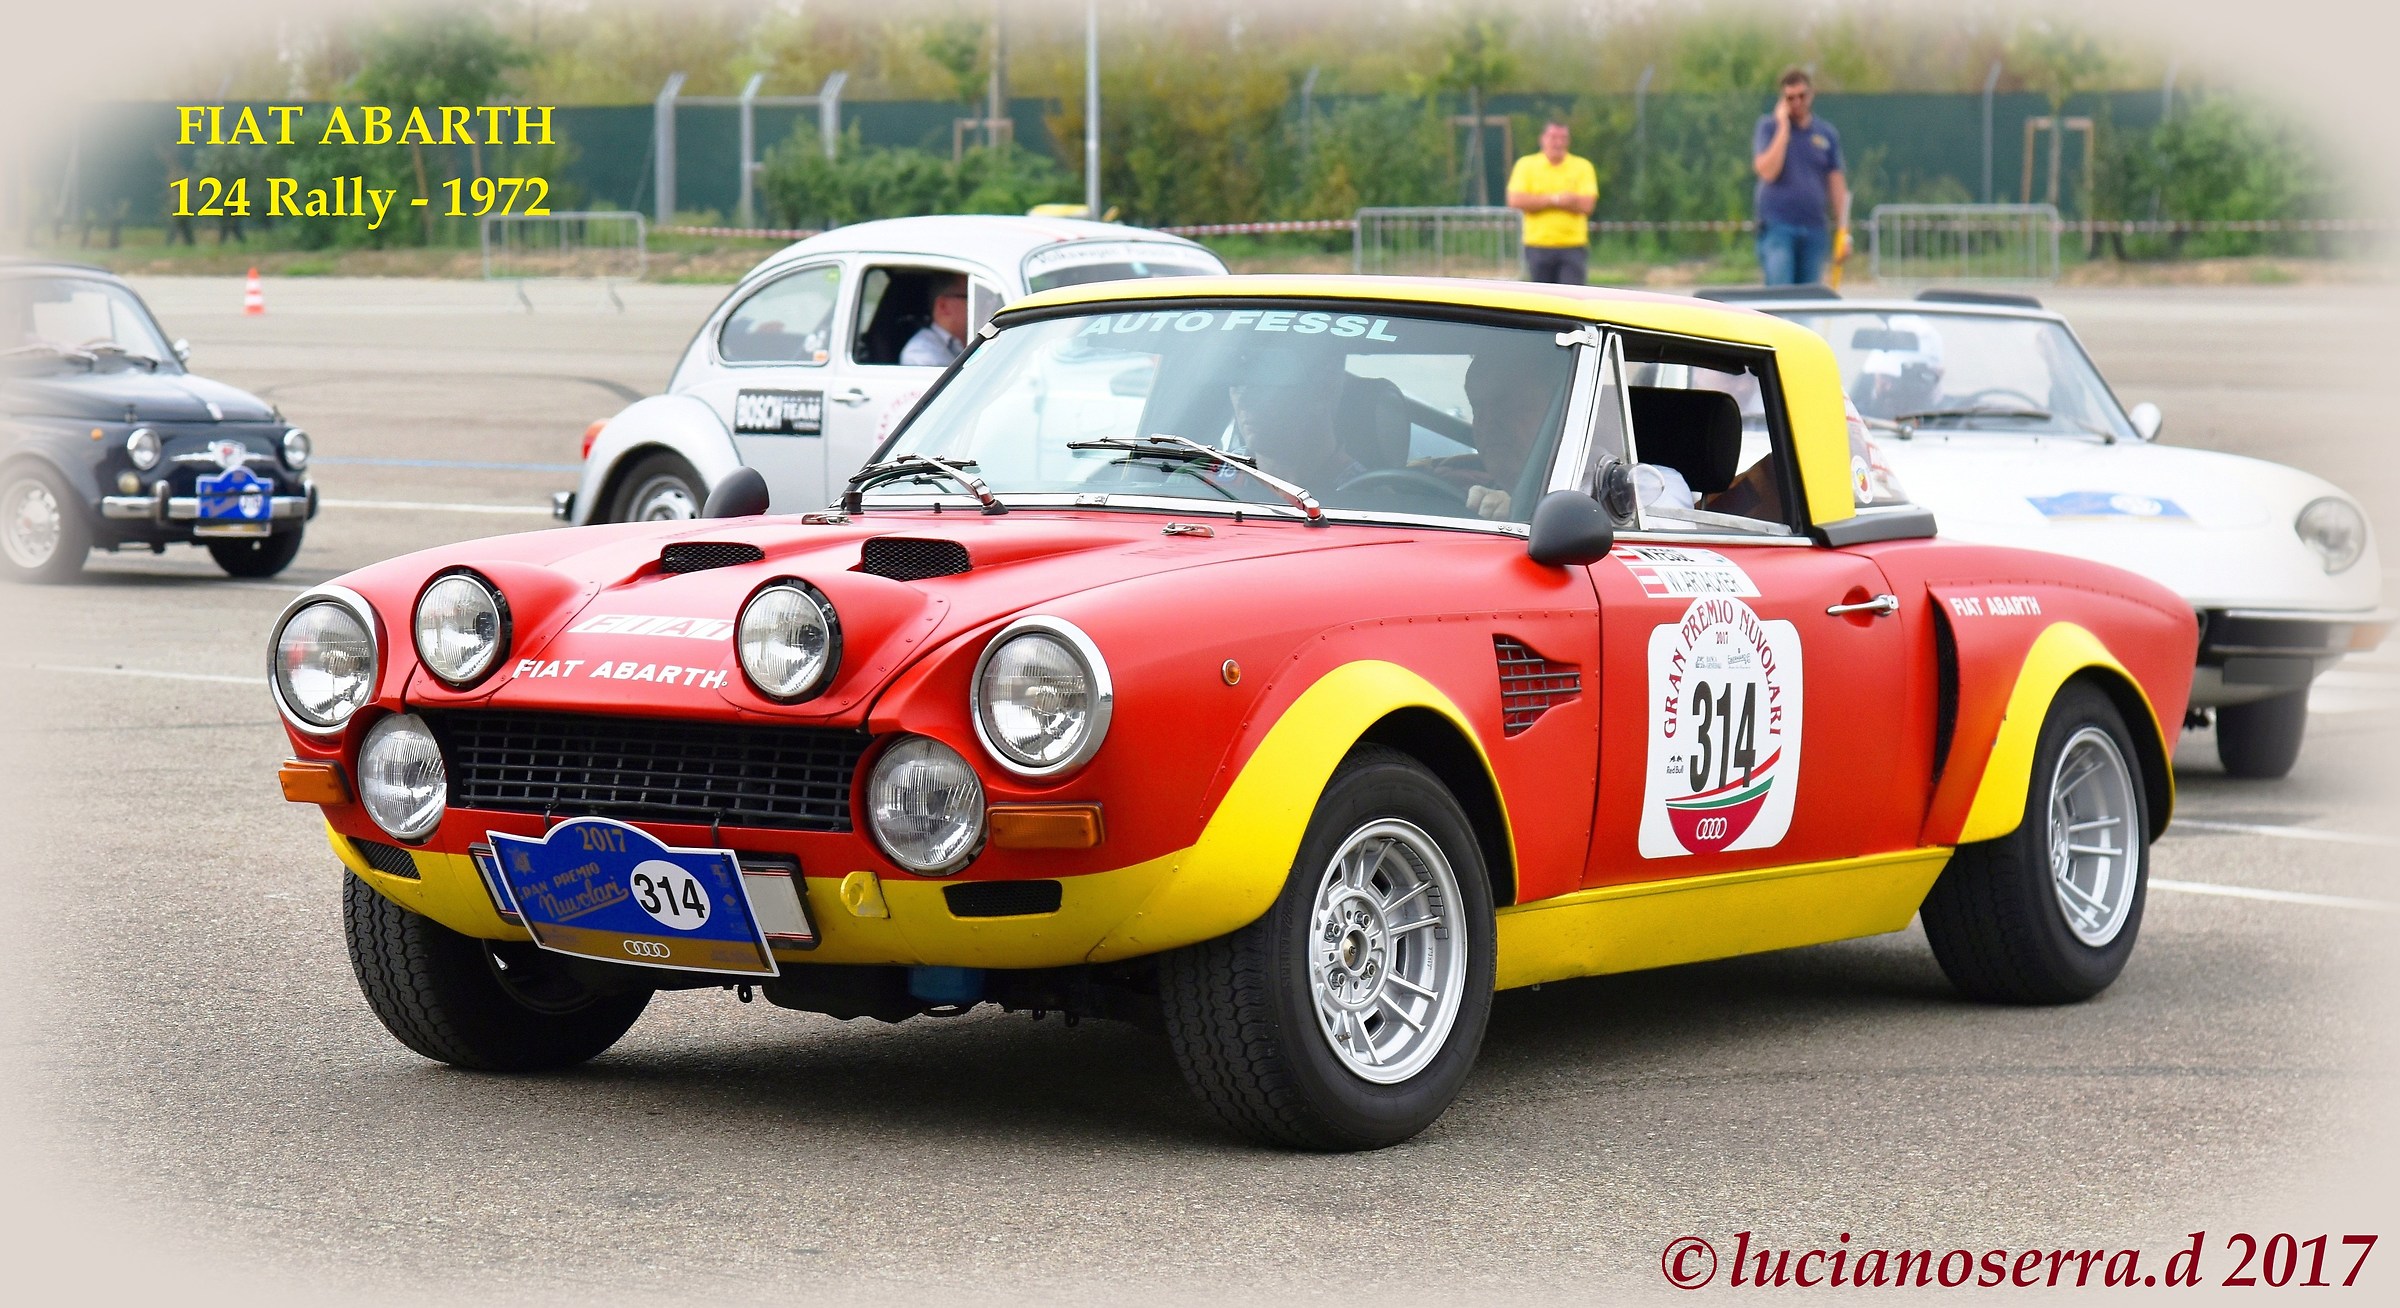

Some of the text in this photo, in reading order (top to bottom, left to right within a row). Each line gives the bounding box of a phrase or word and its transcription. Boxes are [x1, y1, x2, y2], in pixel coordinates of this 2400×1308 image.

[1077, 311, 1398, 342] AUTO FESSL
[736, 394, 783, 430] BOSCH
[783, 402, 821, 420] TEAM
[1949, 596, 2042, 616] FIAT ABARTH
[574, 615, 735, 641] FIAT
[1715, 631, 1729, 645] 2017
[512, 659, 727, 689] FIAT ABARTH
[1664, 599, 1782, 739] GRAN PREMIO NUVOLARI
[1689, 680, 1757, 793] 314
[576, 826, 627, 853] 2017
[553, 861, 601, 888] PREMIO
[538, 874, 629, 922] Nuvolari
[633, 873, 706, 919] 314
